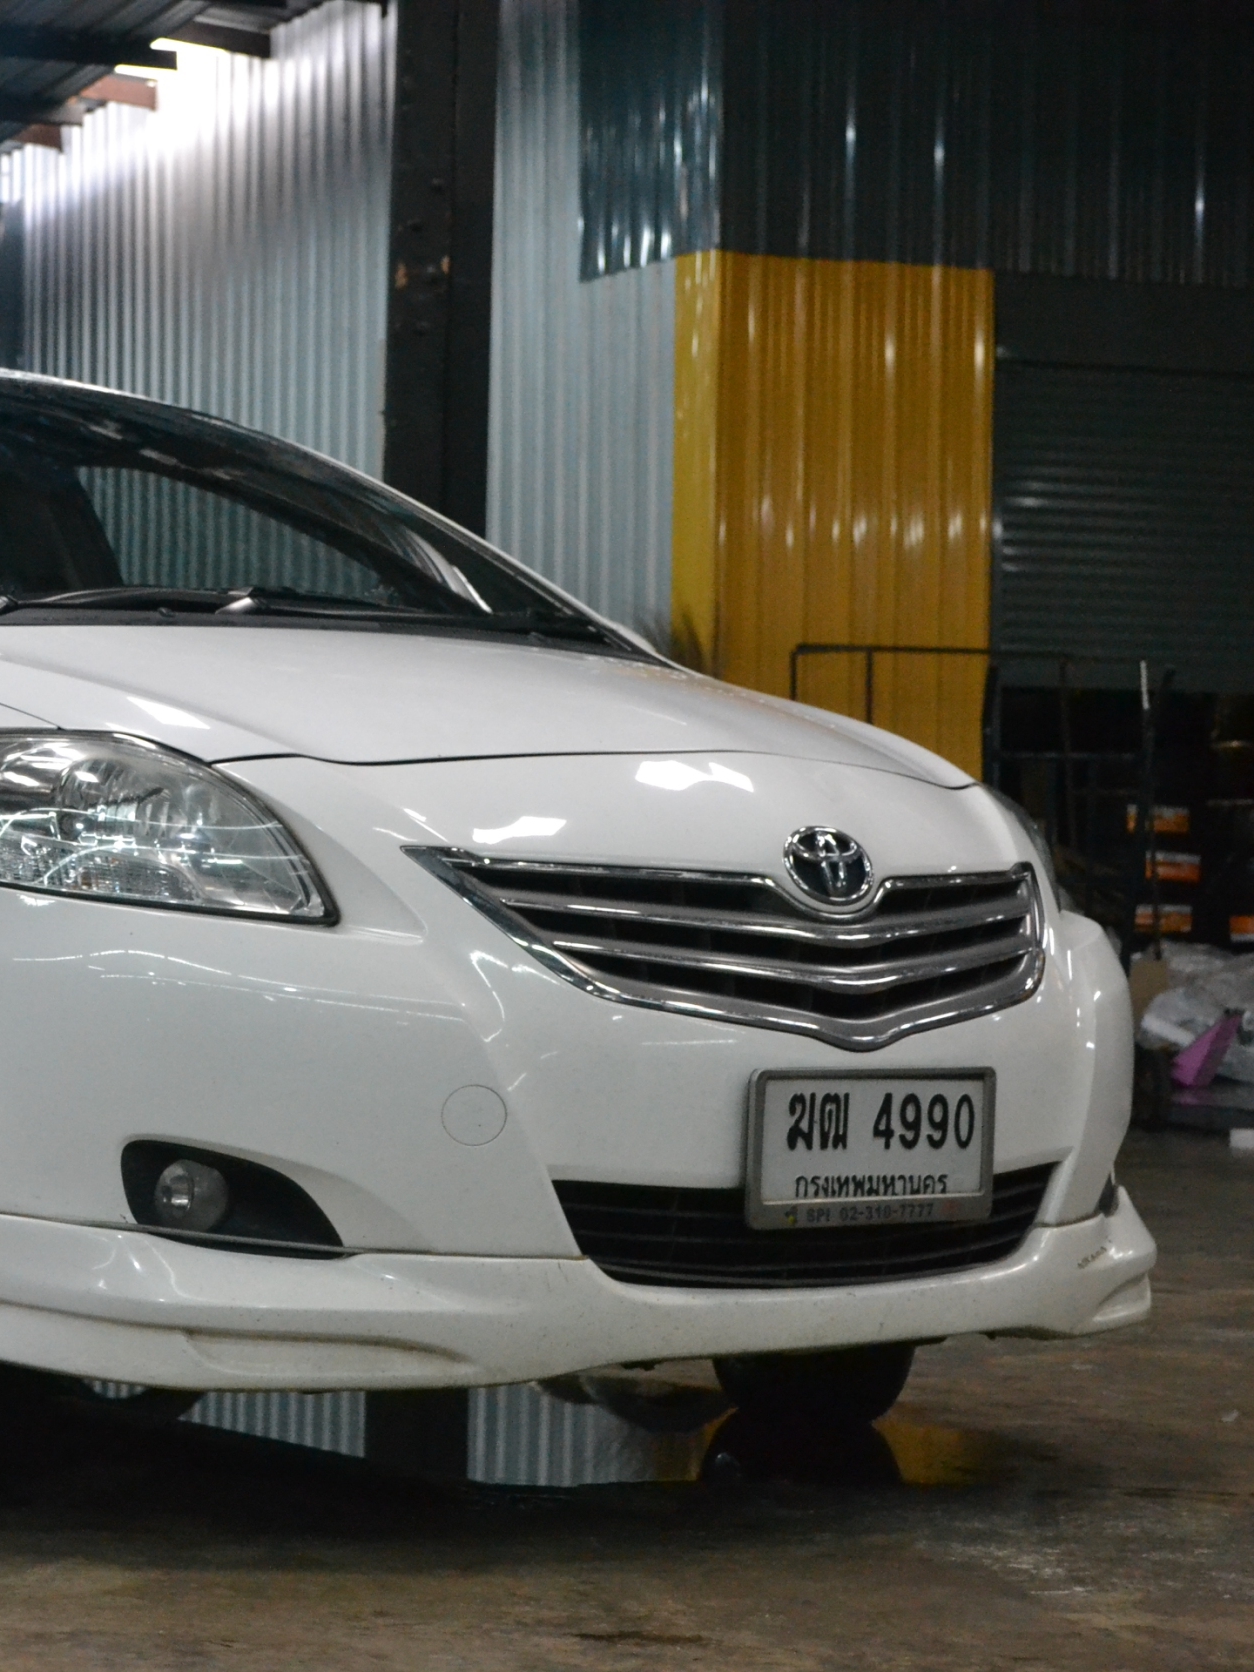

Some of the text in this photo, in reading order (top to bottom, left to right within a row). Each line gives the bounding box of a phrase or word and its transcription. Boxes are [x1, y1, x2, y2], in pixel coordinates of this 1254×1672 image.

[872, 1092, 975, 1150] 4990
[795, 1174, 948, 1198] กรงเทพมหานคร
